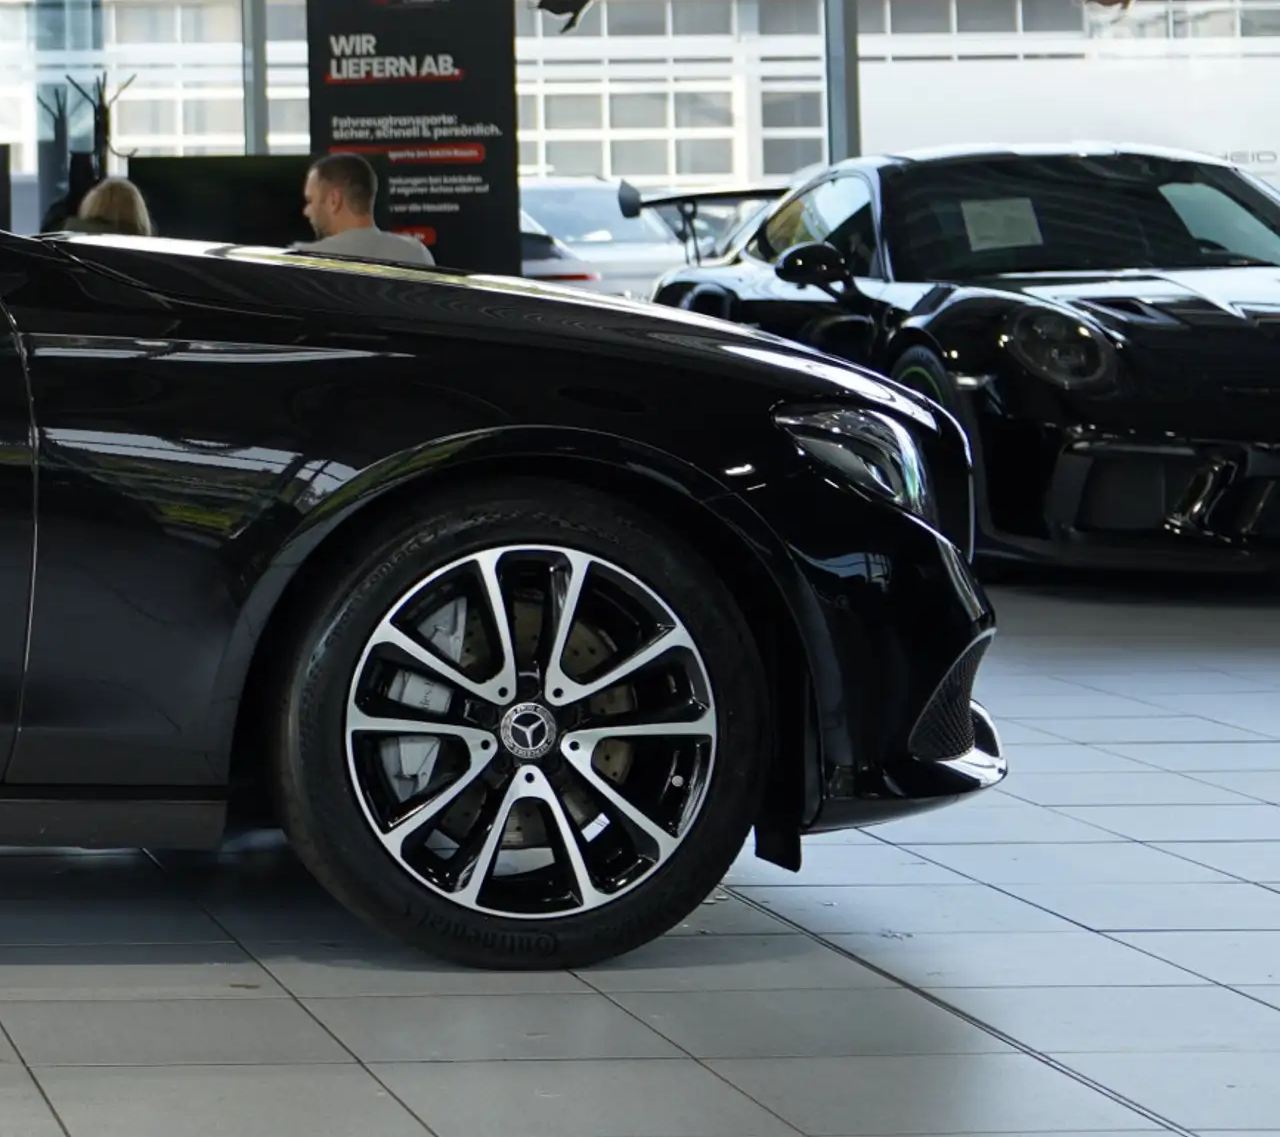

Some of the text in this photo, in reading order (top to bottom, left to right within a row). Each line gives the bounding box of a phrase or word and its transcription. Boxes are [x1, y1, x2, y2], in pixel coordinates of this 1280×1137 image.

[330, 34, 376, 56] WIR
[330, 55, 460, 80] LIEFERN AB.
[332, 114, 458, 130] Fahrzeugtransporte:
[332, 126, 373, 140] sicher,
[375, 125, 420, 138] schnell
[433, 123, 502, 140] persönlich.
